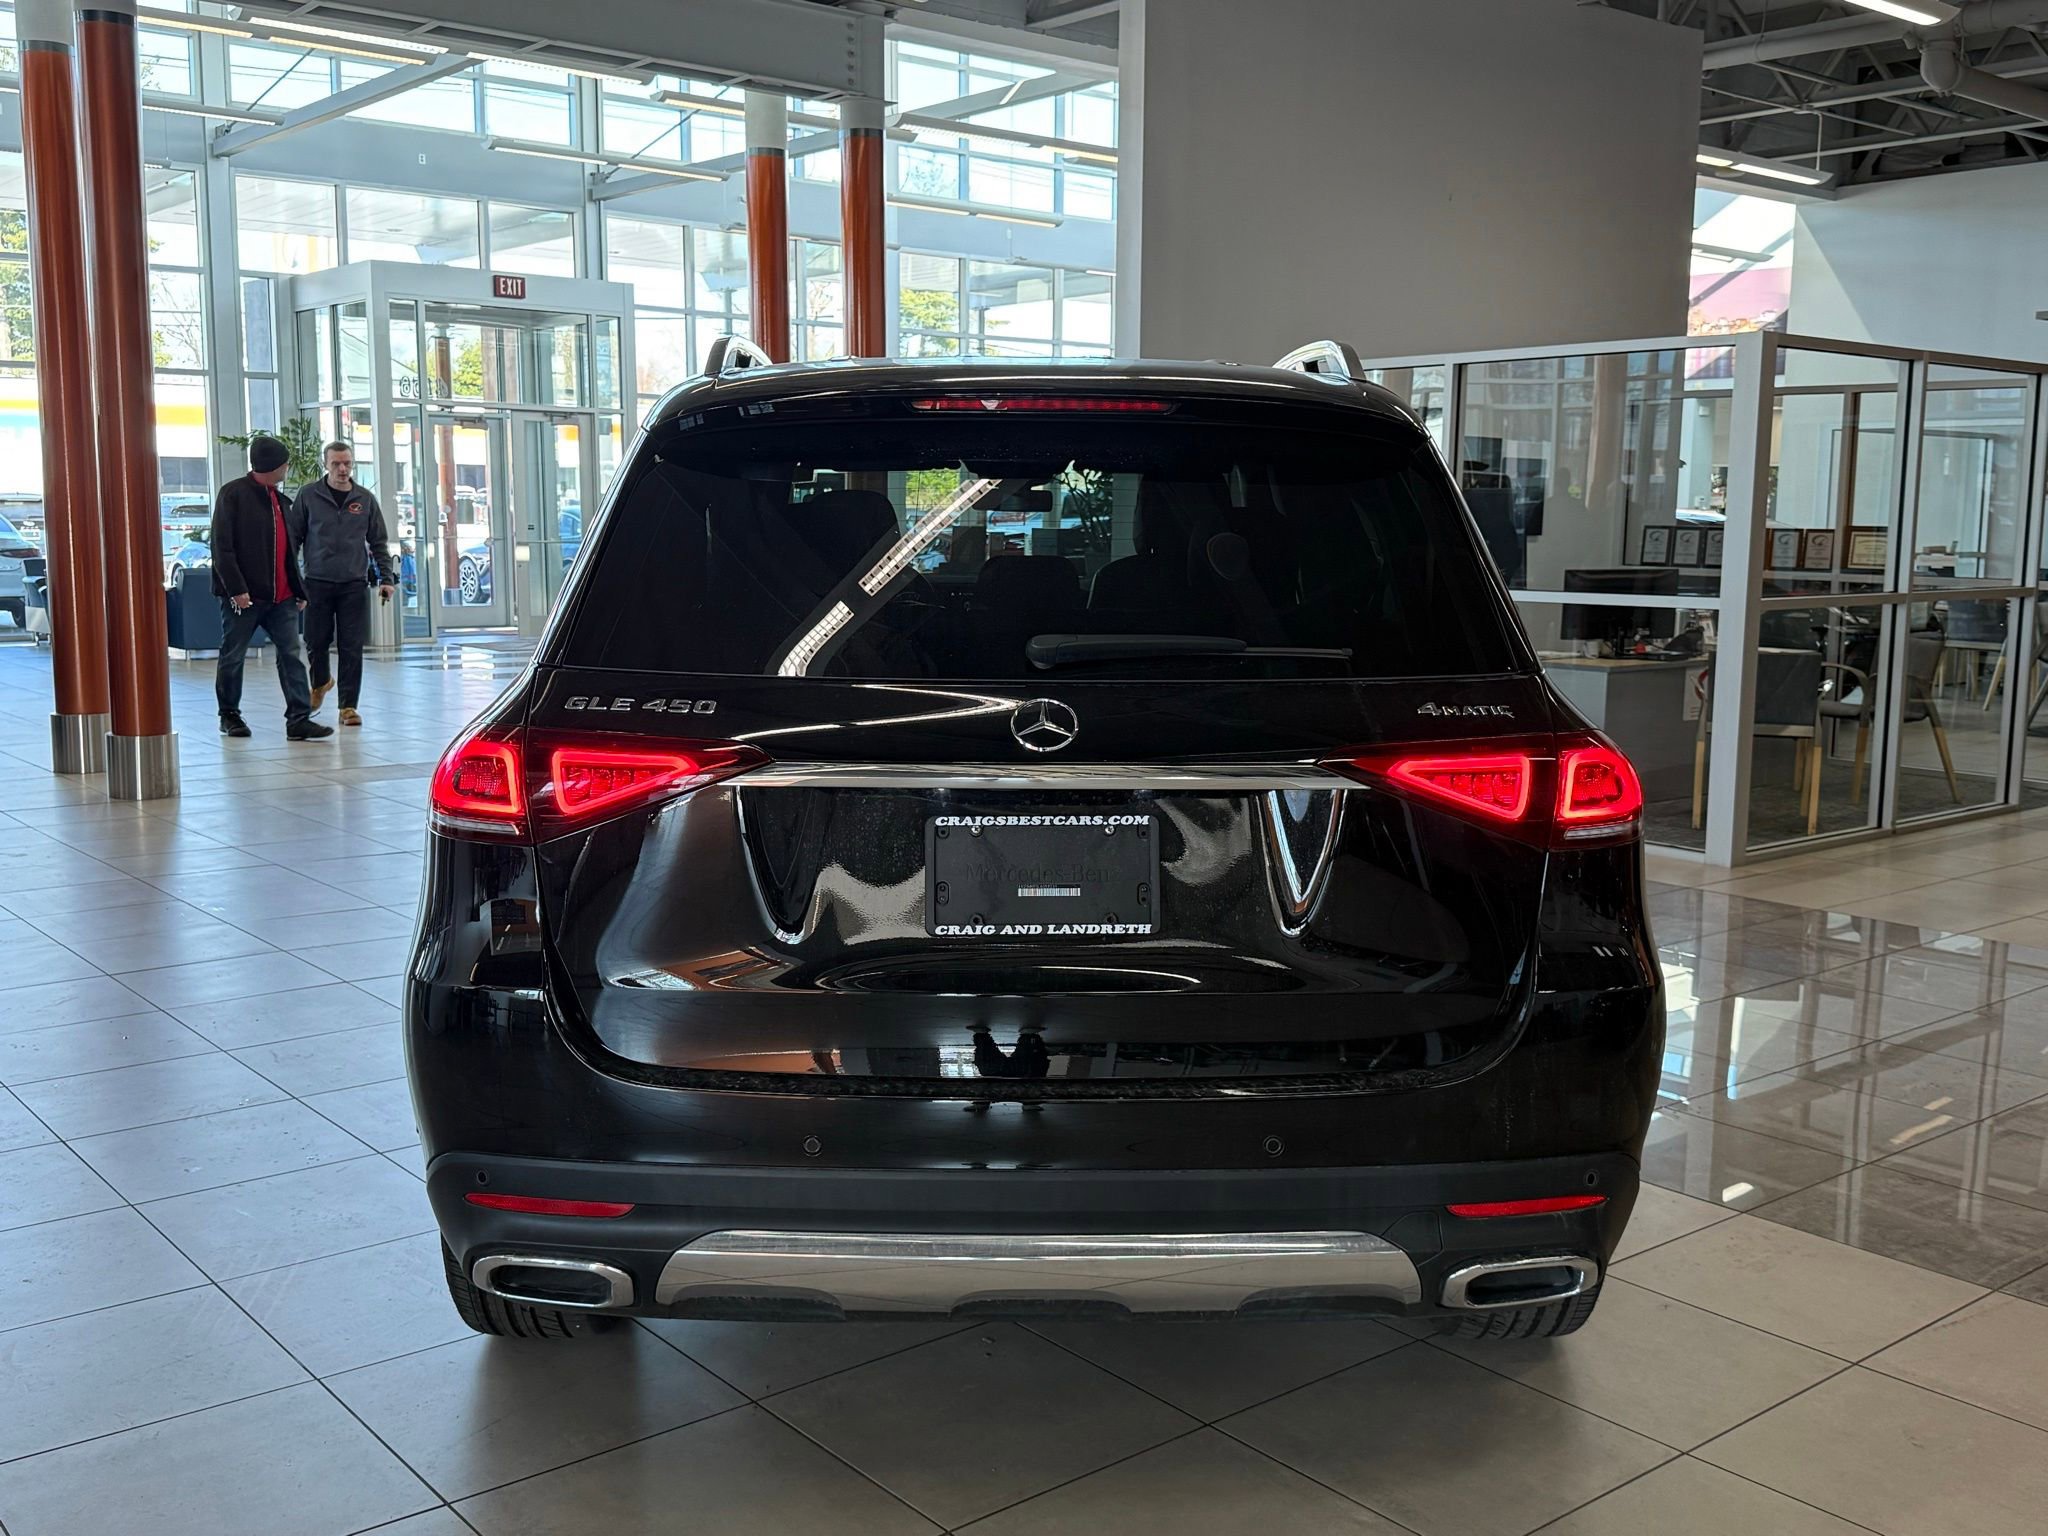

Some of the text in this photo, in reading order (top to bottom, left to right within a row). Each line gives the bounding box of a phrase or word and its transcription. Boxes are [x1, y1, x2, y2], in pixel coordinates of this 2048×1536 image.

[500, 277, 522, 297] EXIT
[564, 696, 717, 714] GLE 450
[934, 815, 1150, 827] CRAIGSBESTCARS.COM
[934, 923, 1152, 936] CRAIG AND LANDRETH
